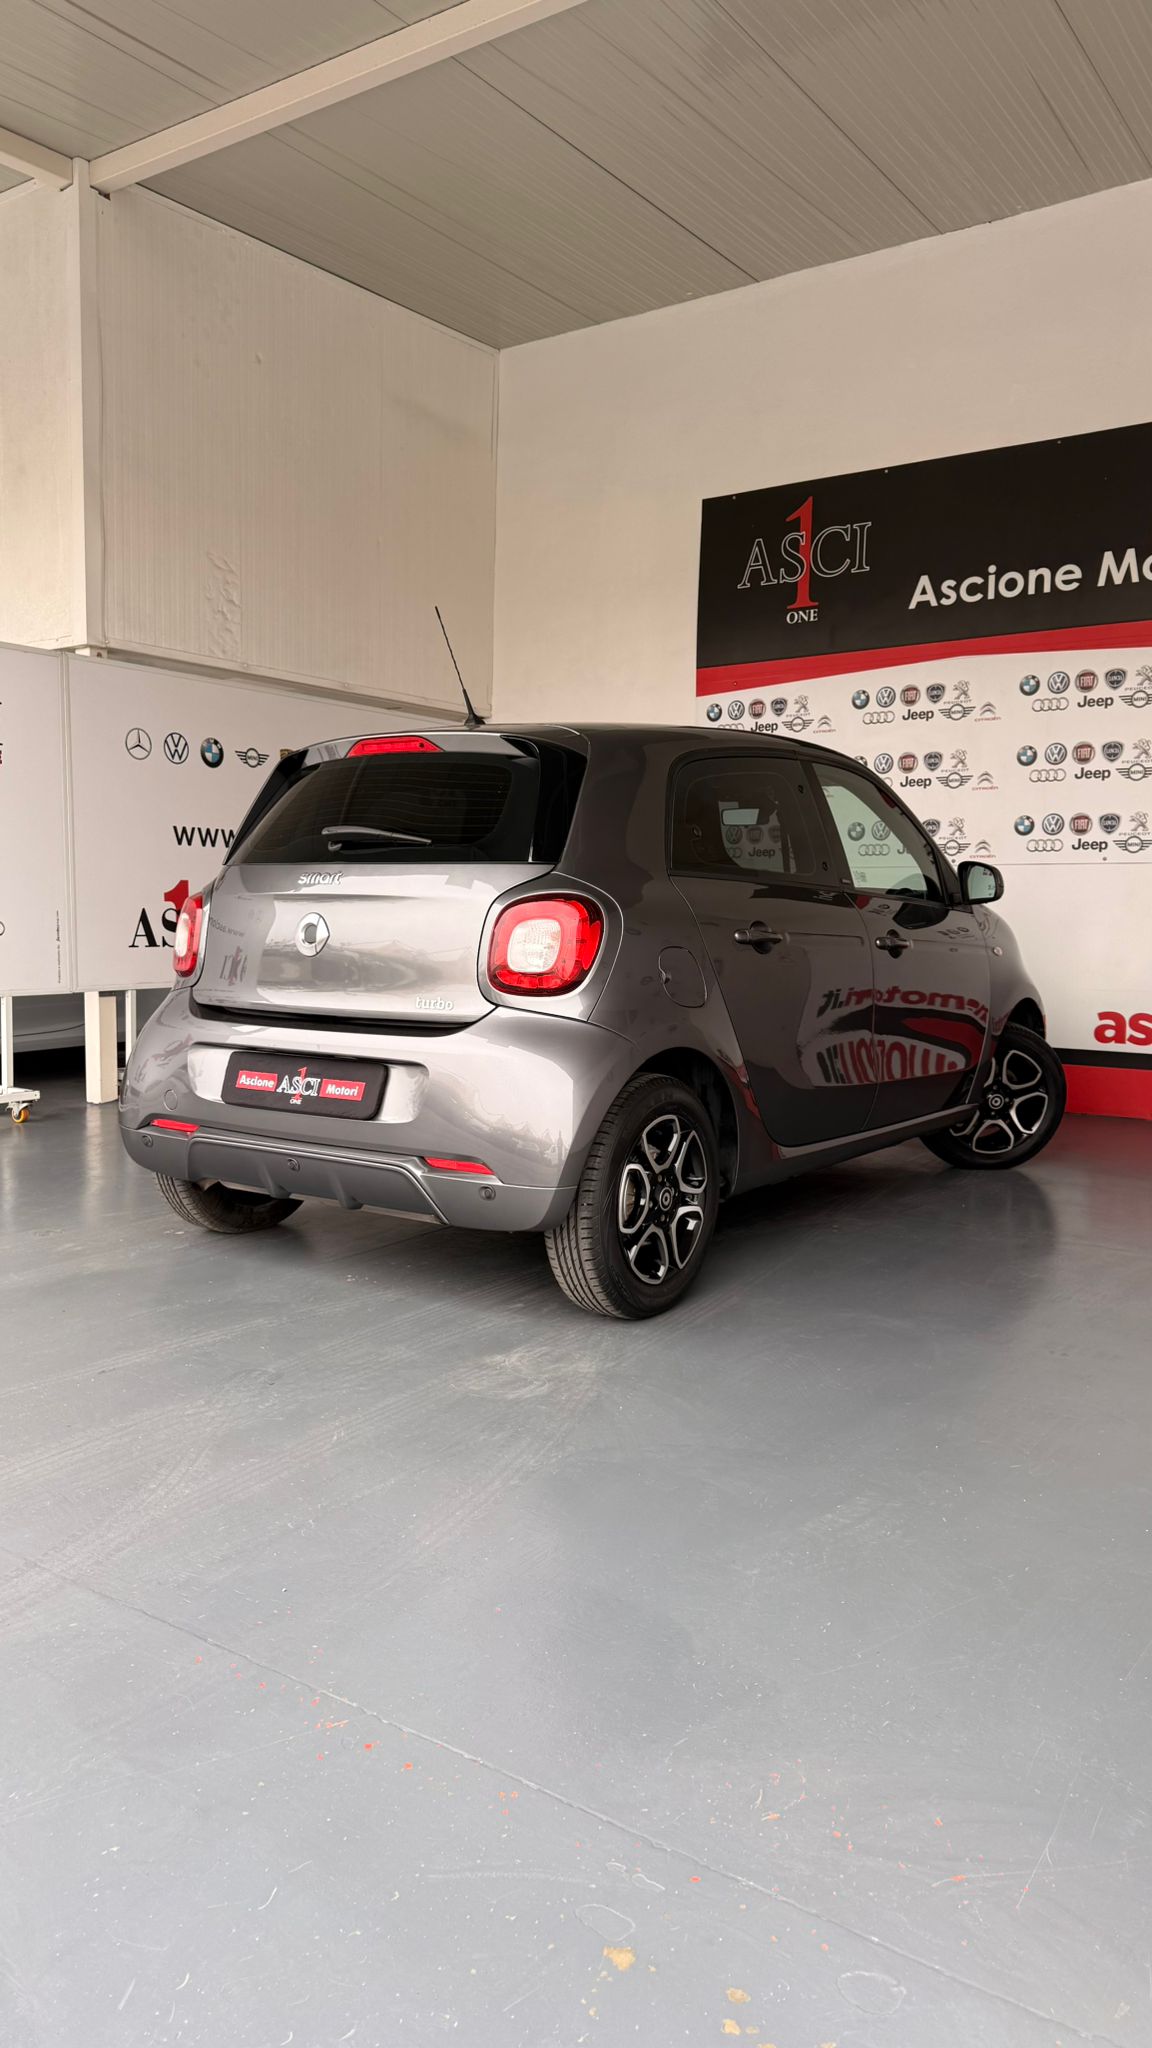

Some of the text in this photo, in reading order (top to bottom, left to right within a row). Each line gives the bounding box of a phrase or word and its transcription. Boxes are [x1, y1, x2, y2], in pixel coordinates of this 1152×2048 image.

[908, 562, 1083, 610] Ascione
[786, 608, 819, 625] ONE
[1077, 695, 1114, 709] Jeep
[902, 709, 934, 722] Jeep
[750, 721, 778, 733] Jeep
[1074, 767, 1111, 781] Jeep
[900, 776, 932, 789] Jeep
[1072, 838, 1108, 852] Jeep
[748, 846, 776, 859] Jeep
[297, 871, 344, 886] smart
[415, 996, 454, 1010] turbo
[239, 1075, 275, 1088] Ascione
[326, 1084, 359, 1096] Motori
